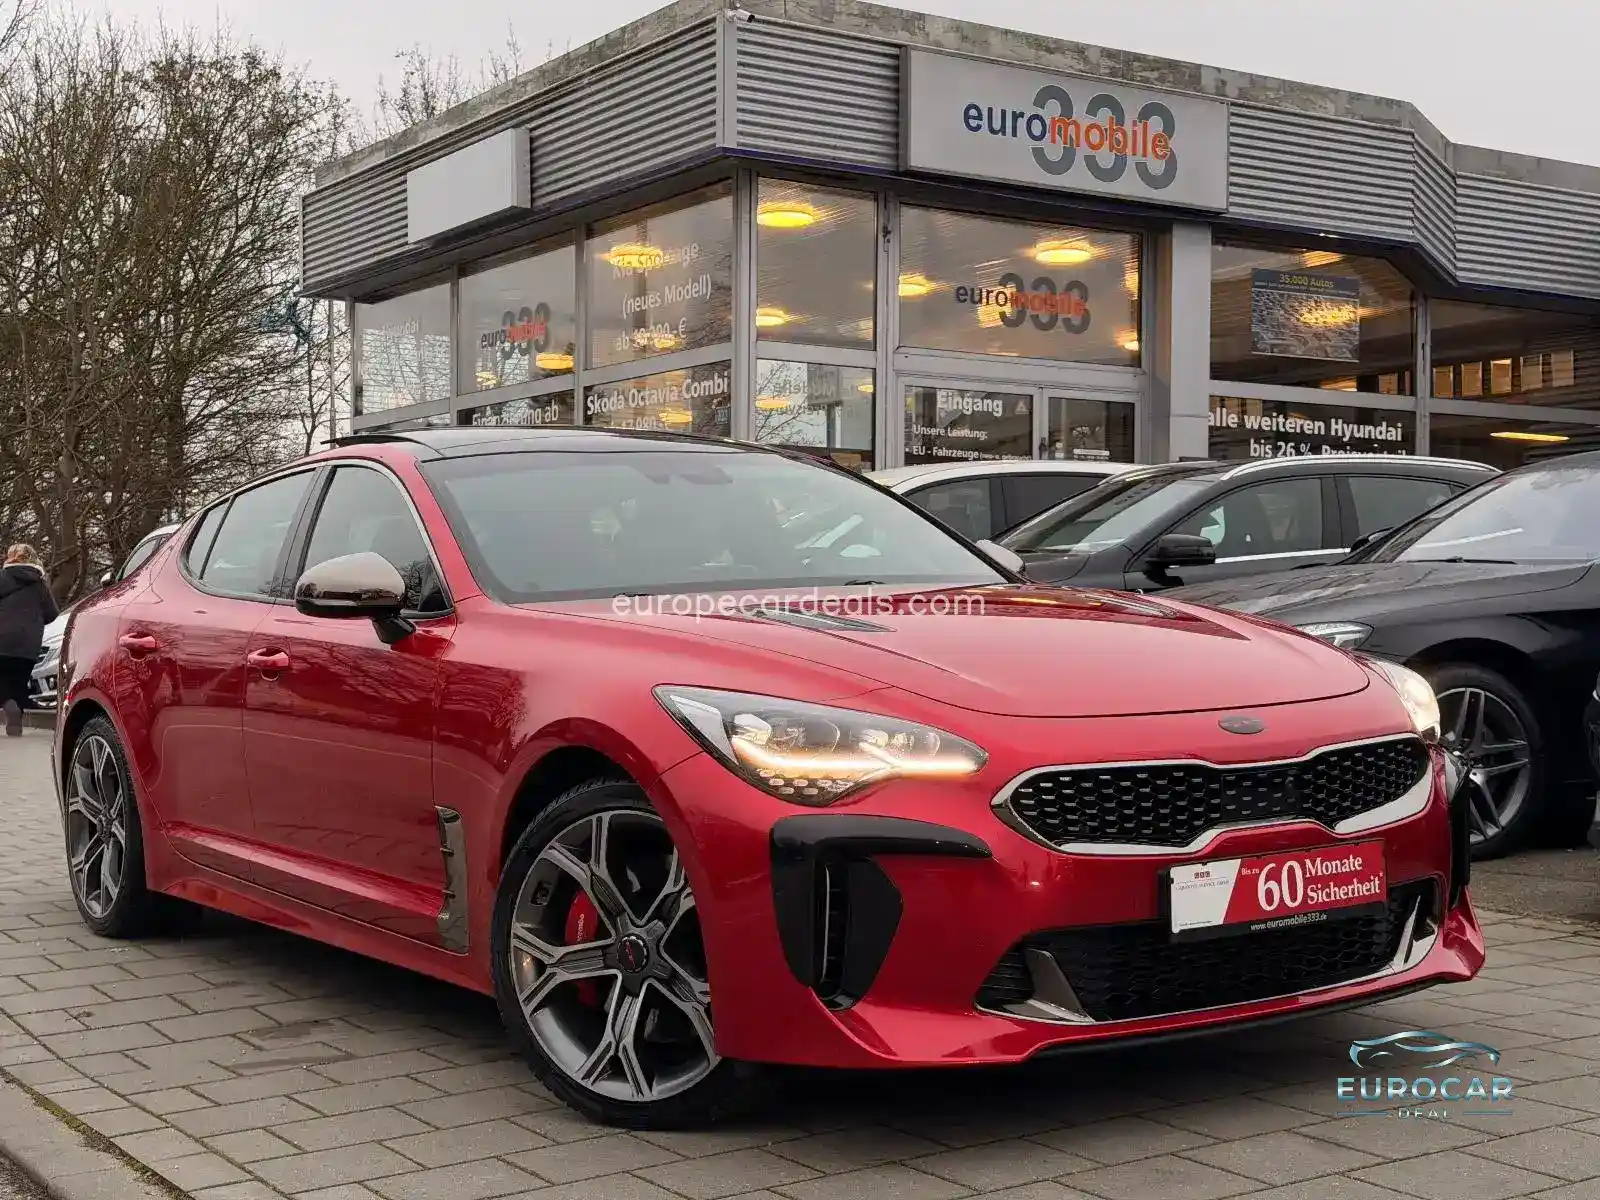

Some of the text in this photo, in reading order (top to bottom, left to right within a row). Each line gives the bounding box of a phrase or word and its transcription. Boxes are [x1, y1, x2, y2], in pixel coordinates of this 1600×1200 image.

[963, 102, 1171, 161] euromobile
[1029, 84, 1178, 190] 333
[622, 273, 711, 320] (neues Modell)
[955, 285, 1087, 318] euromobile
[629, 383, 679, 408] Octavia
[682, 371, 728, 398] Combi
[937, 388, 1003, 417] Eingang
[544, 398, 559, 422] ab
[1208, 407, 1402, 442] alle weiteren Hyundai
[912, 424, 945, 436] Unsere
[913, 446, 926, 455] EU
[933, 447, 979, 460] Fahrzeuge
[1250, 438, 1272, 458] bis
[1277, 442, 1295, 458] 26
[1305, 854, 1363, 878] Monate
[1257, 861, 1304, 911] 60
[1250, 912, 1327, 931] www.euromobile333.de
